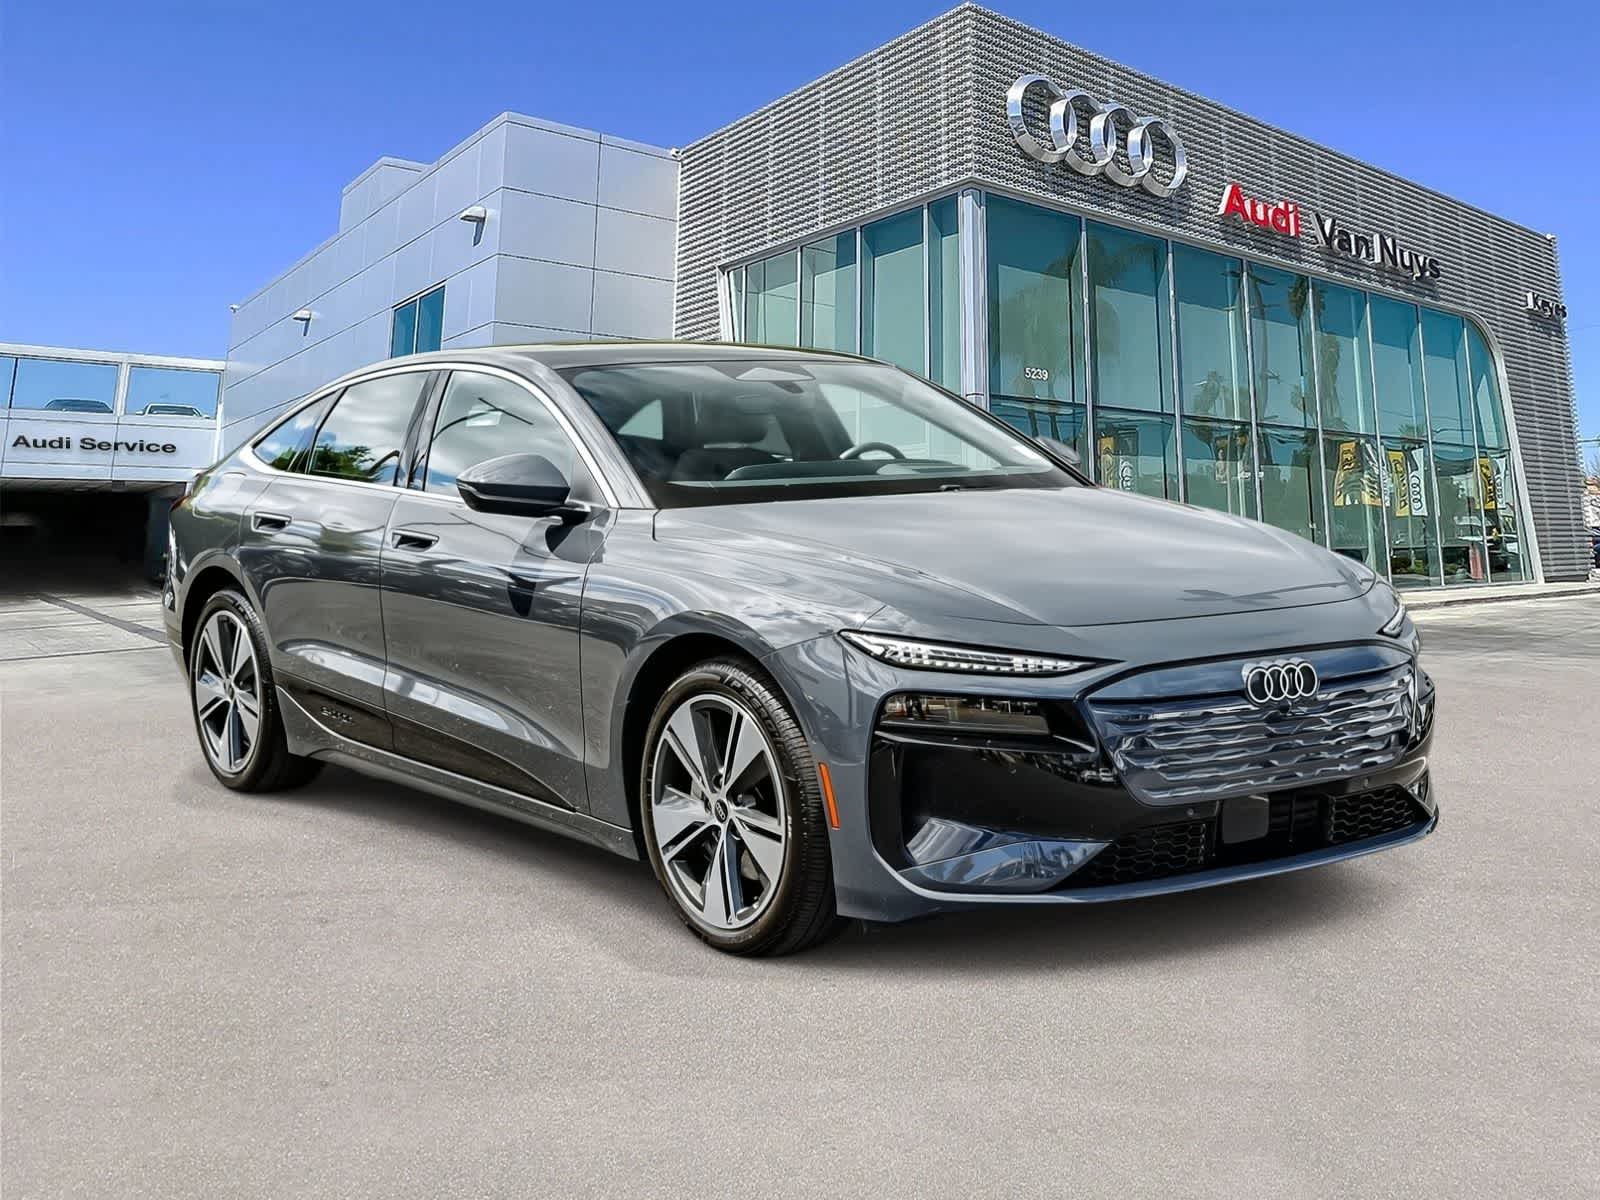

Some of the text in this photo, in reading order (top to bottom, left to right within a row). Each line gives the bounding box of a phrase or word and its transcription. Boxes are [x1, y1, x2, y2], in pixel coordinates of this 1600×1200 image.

[1217, 182, 1442, 280] Audi Van Nuys
[1024, 367, 1049, 381] 5239
[12, 435, 177, 453] Audi Service
